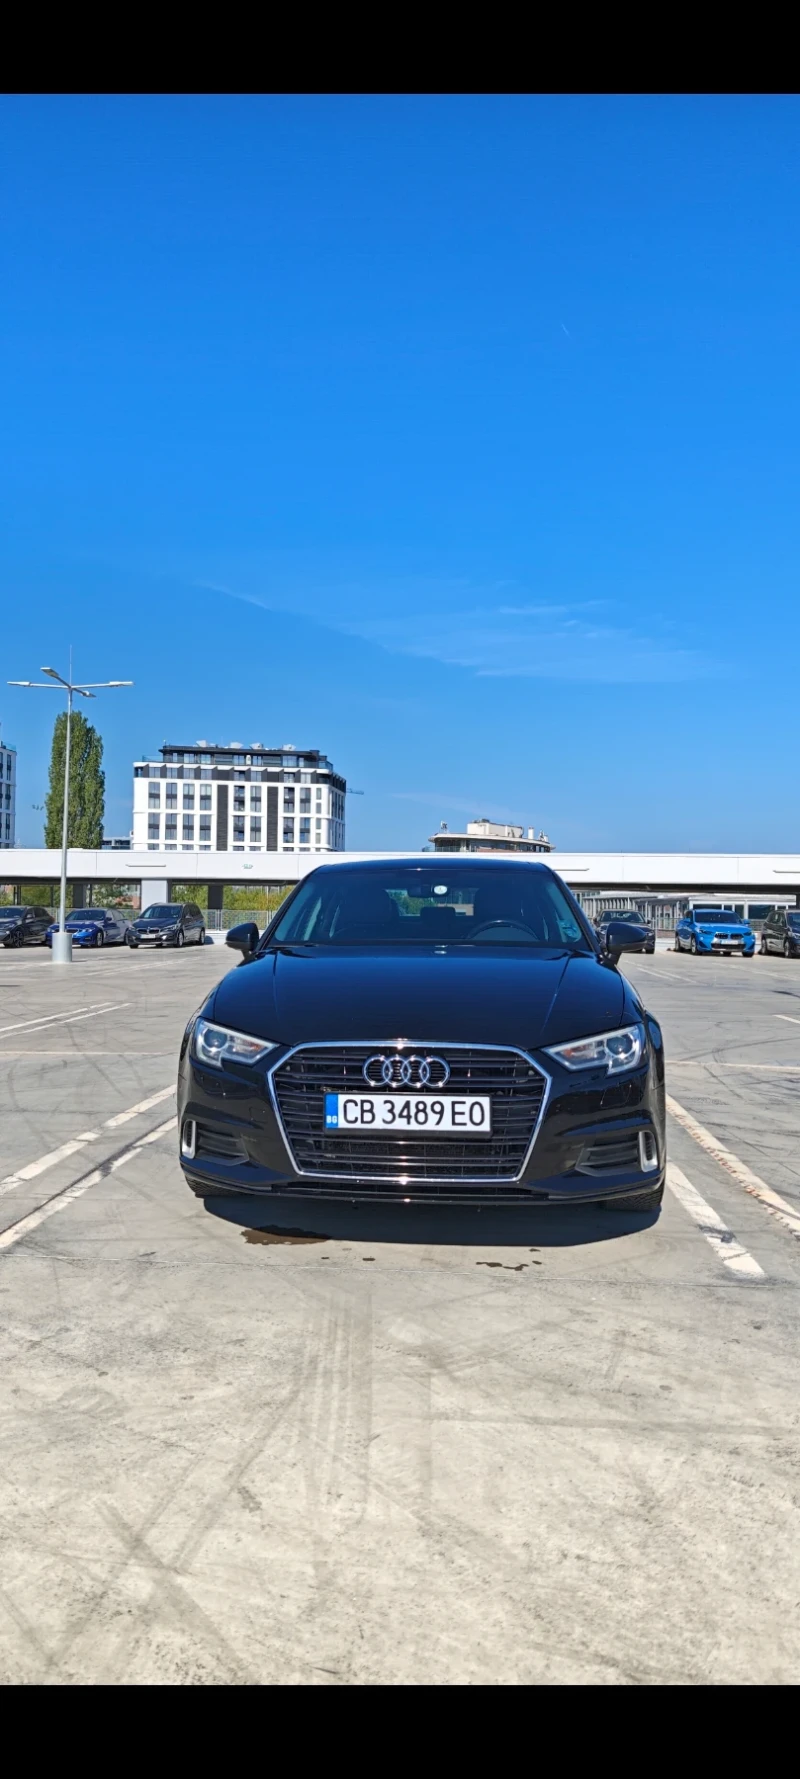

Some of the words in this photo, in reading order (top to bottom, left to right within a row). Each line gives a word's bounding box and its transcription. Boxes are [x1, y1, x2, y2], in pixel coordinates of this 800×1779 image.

[343, 1099, 376, 1124] CB
[382, 1100, 445, 1126] 3489
[451, 1101, 485, 1126] EO
